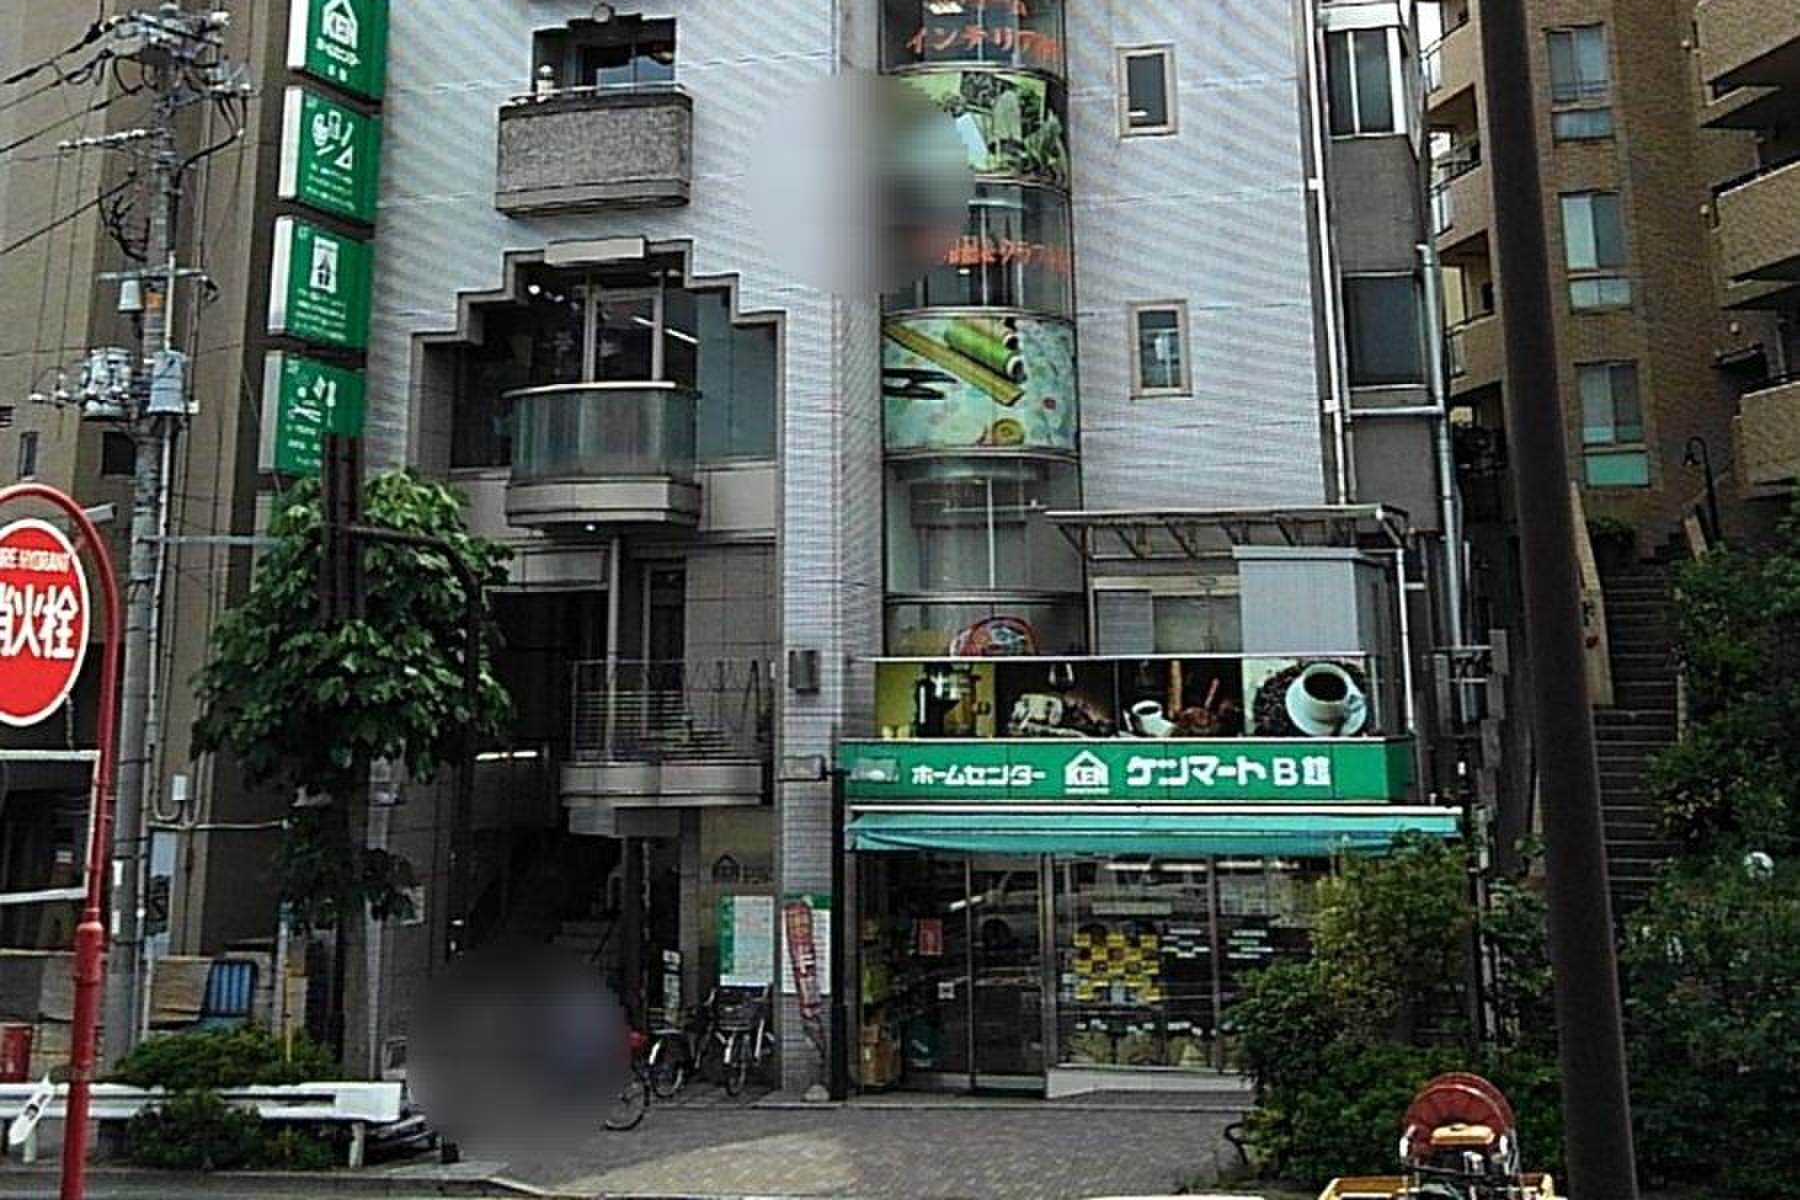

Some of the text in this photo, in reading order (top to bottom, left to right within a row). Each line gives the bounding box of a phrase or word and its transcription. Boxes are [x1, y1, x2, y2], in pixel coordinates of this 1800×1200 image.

[911, 764, 1046, 786] ホームセンター
